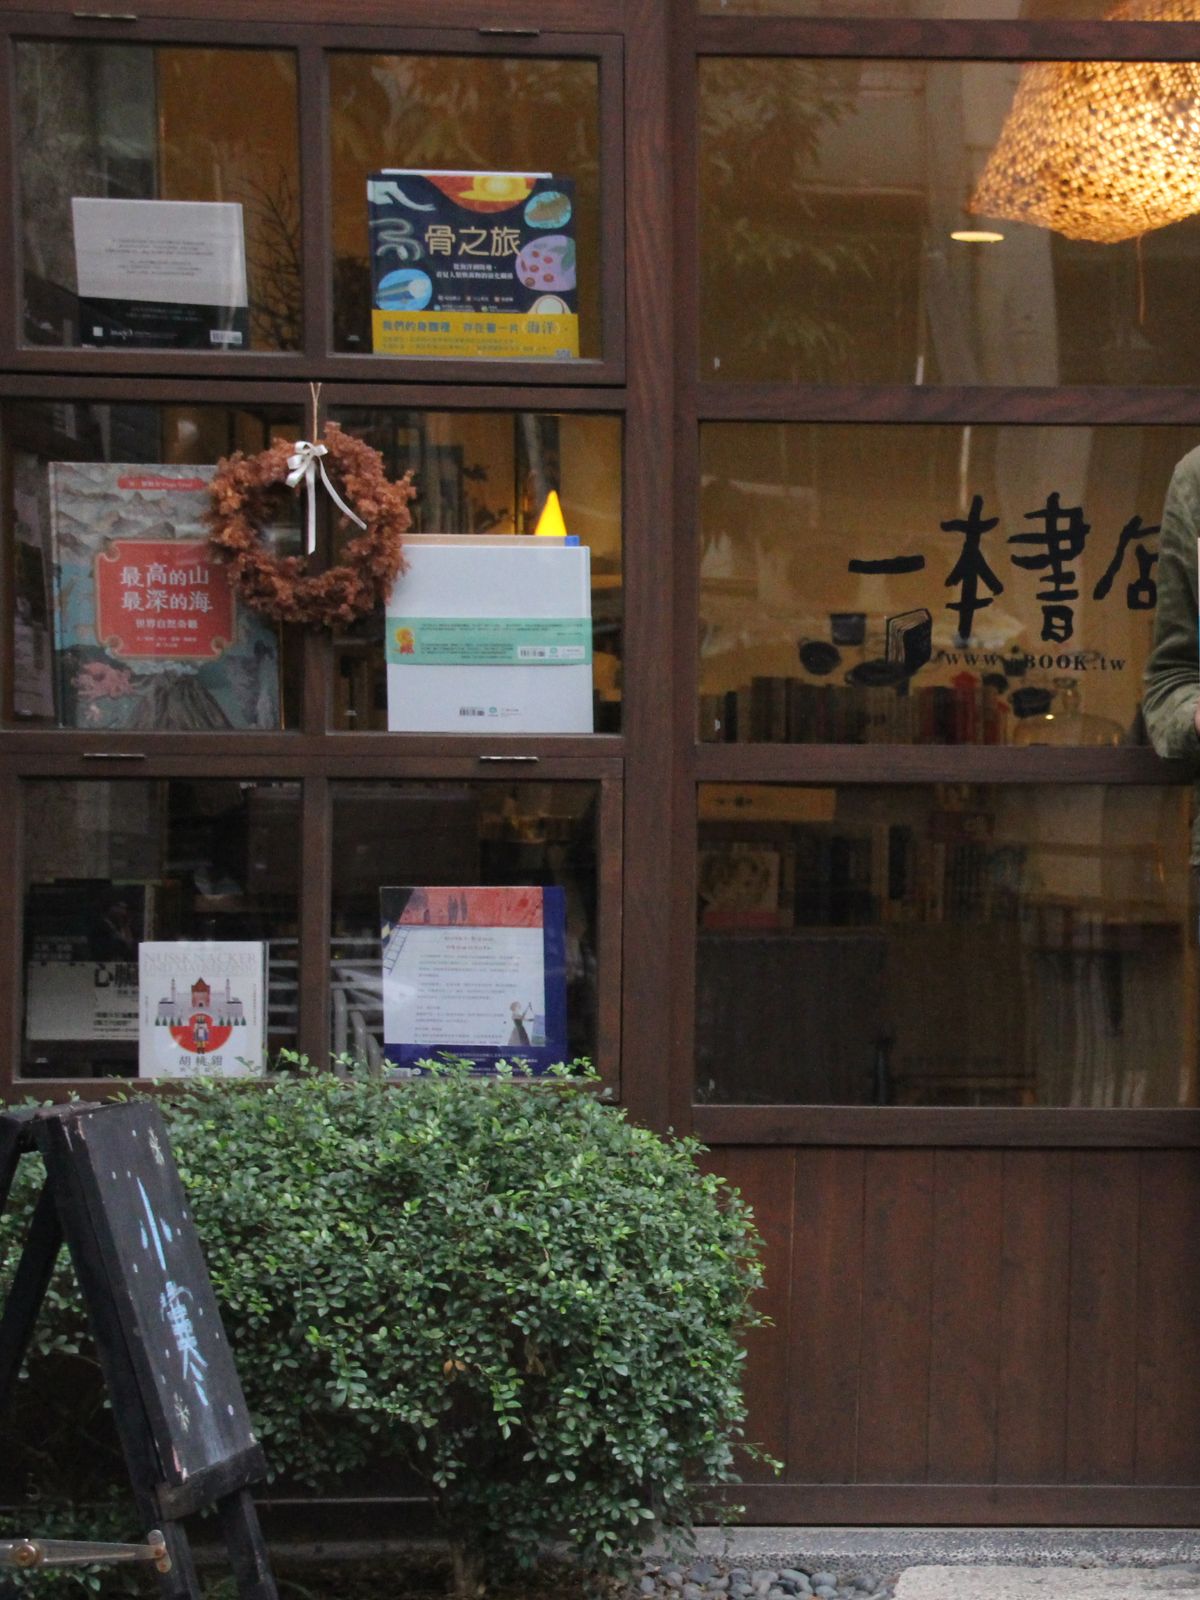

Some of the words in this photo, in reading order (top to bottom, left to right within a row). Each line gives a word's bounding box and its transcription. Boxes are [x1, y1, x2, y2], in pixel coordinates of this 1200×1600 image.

[424, 225, 521, 257] 骨之旅
[121, 562, 209, 587] 最高的山
[121, 589, 213, 613] 最深的海
